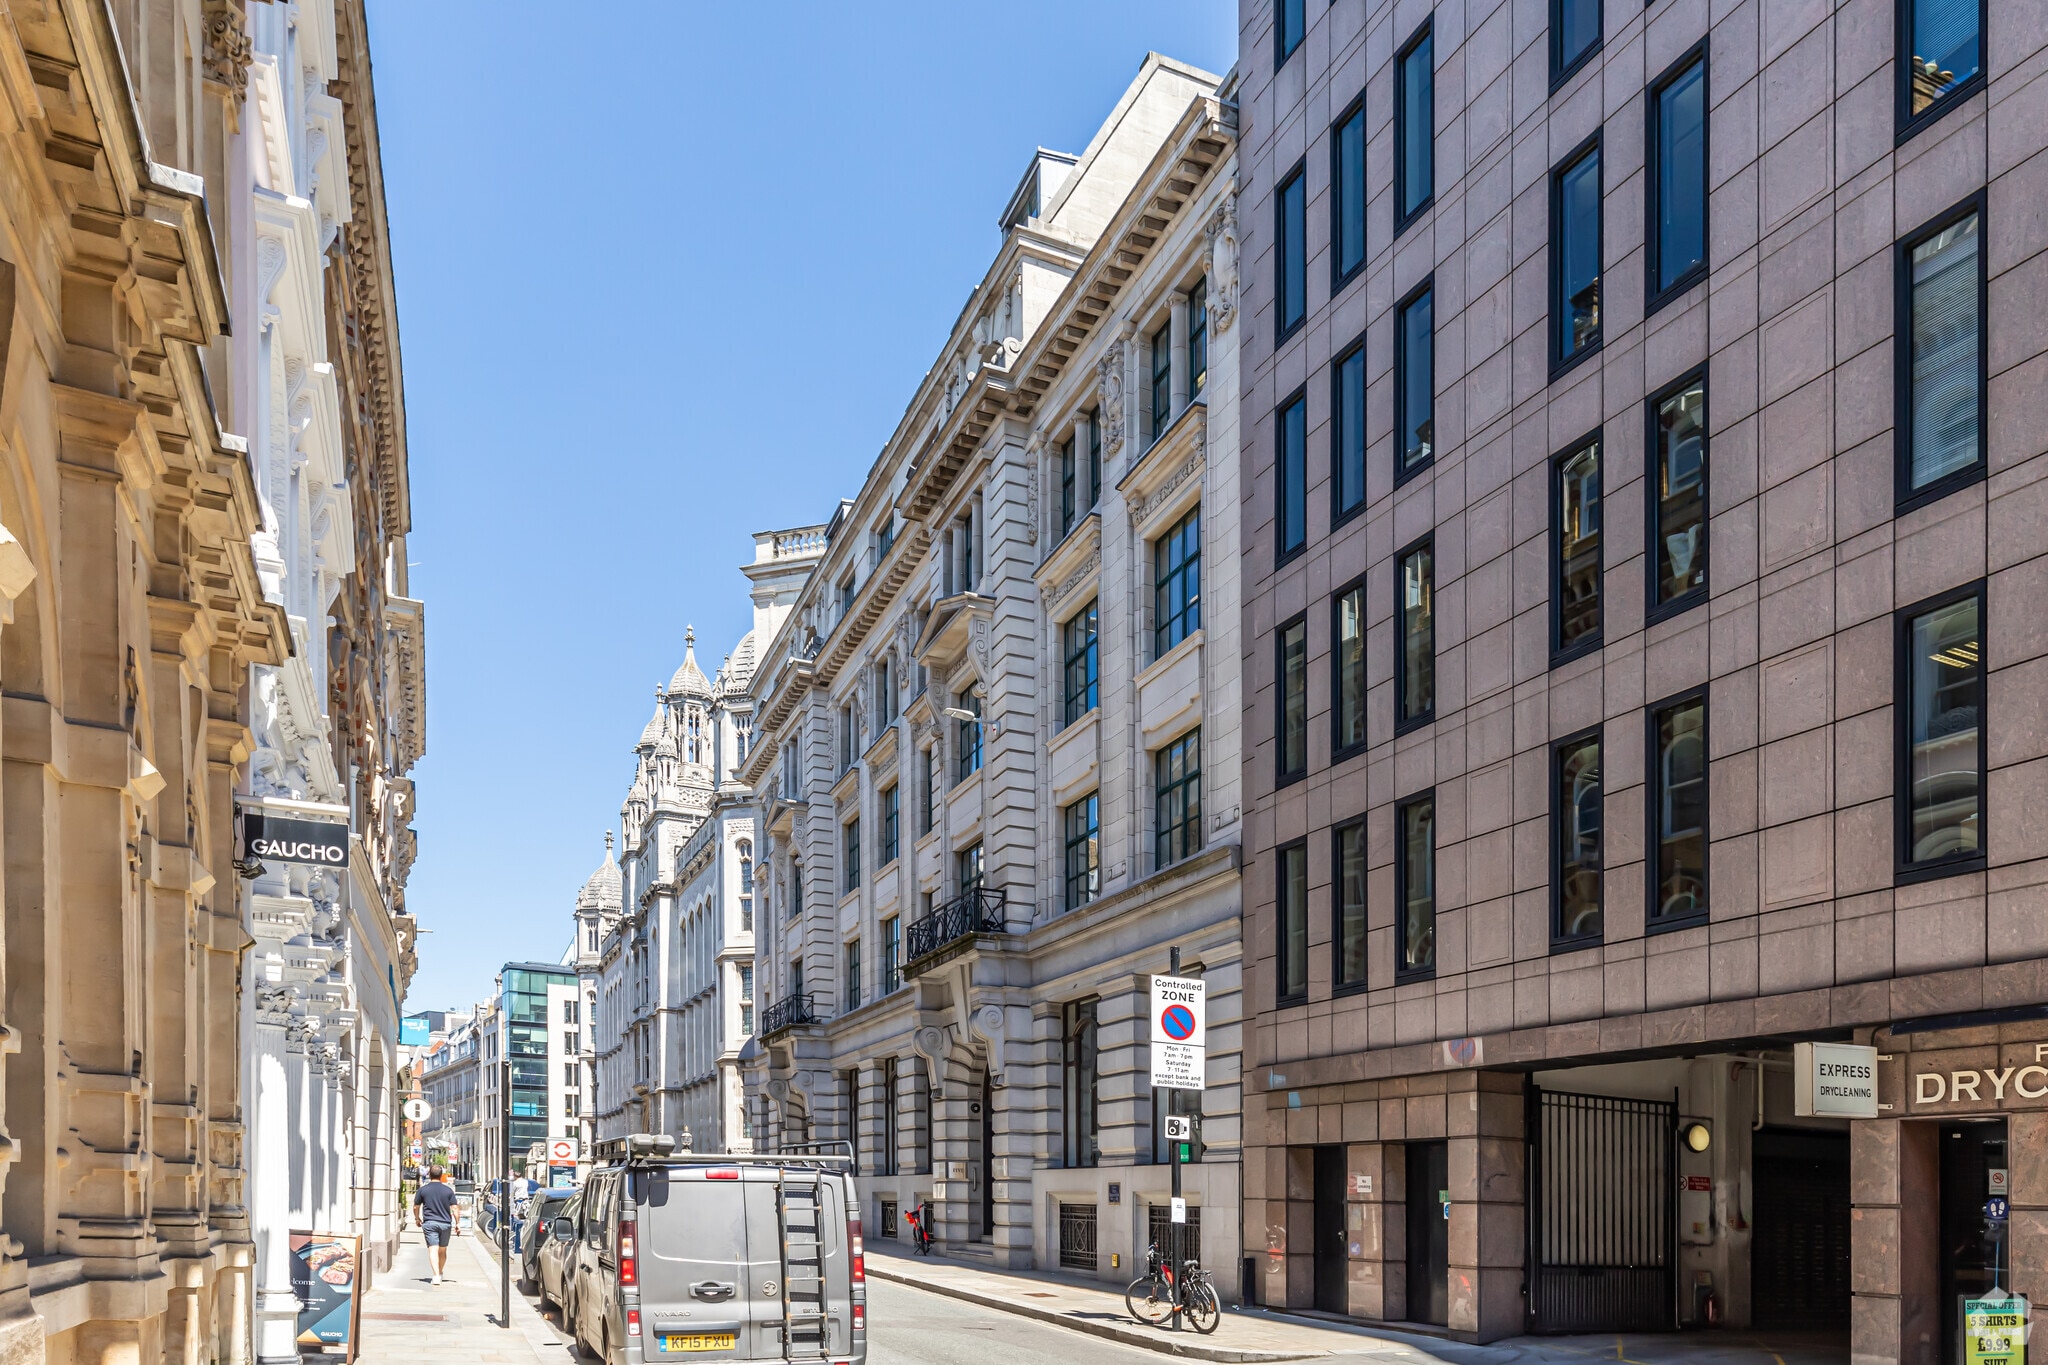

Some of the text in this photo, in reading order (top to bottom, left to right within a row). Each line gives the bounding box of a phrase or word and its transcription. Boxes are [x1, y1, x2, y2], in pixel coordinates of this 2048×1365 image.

[251, 838, 344, 862] GAUCHO
[1155, 979, 1202, 991] Controlled
[1162, 990, 1195, 1002] ZONE
[1819, 1063, 1871, 1079] EXPRESS
[1915, 1065, 2048, 1104] DRYC
[1820, 1086, 1872, 1098] DRYCLEANING
[291, 1277, 316, 1286] lcome
[1966, 1302, 1997, 1310] SPECIAL
[1971, 1315, 2016, 1326] 5 SHIRTS
[671, 1335, 730, 1349] KF15 FXU
[1977, 1337, 2011, 1352] £9.99
